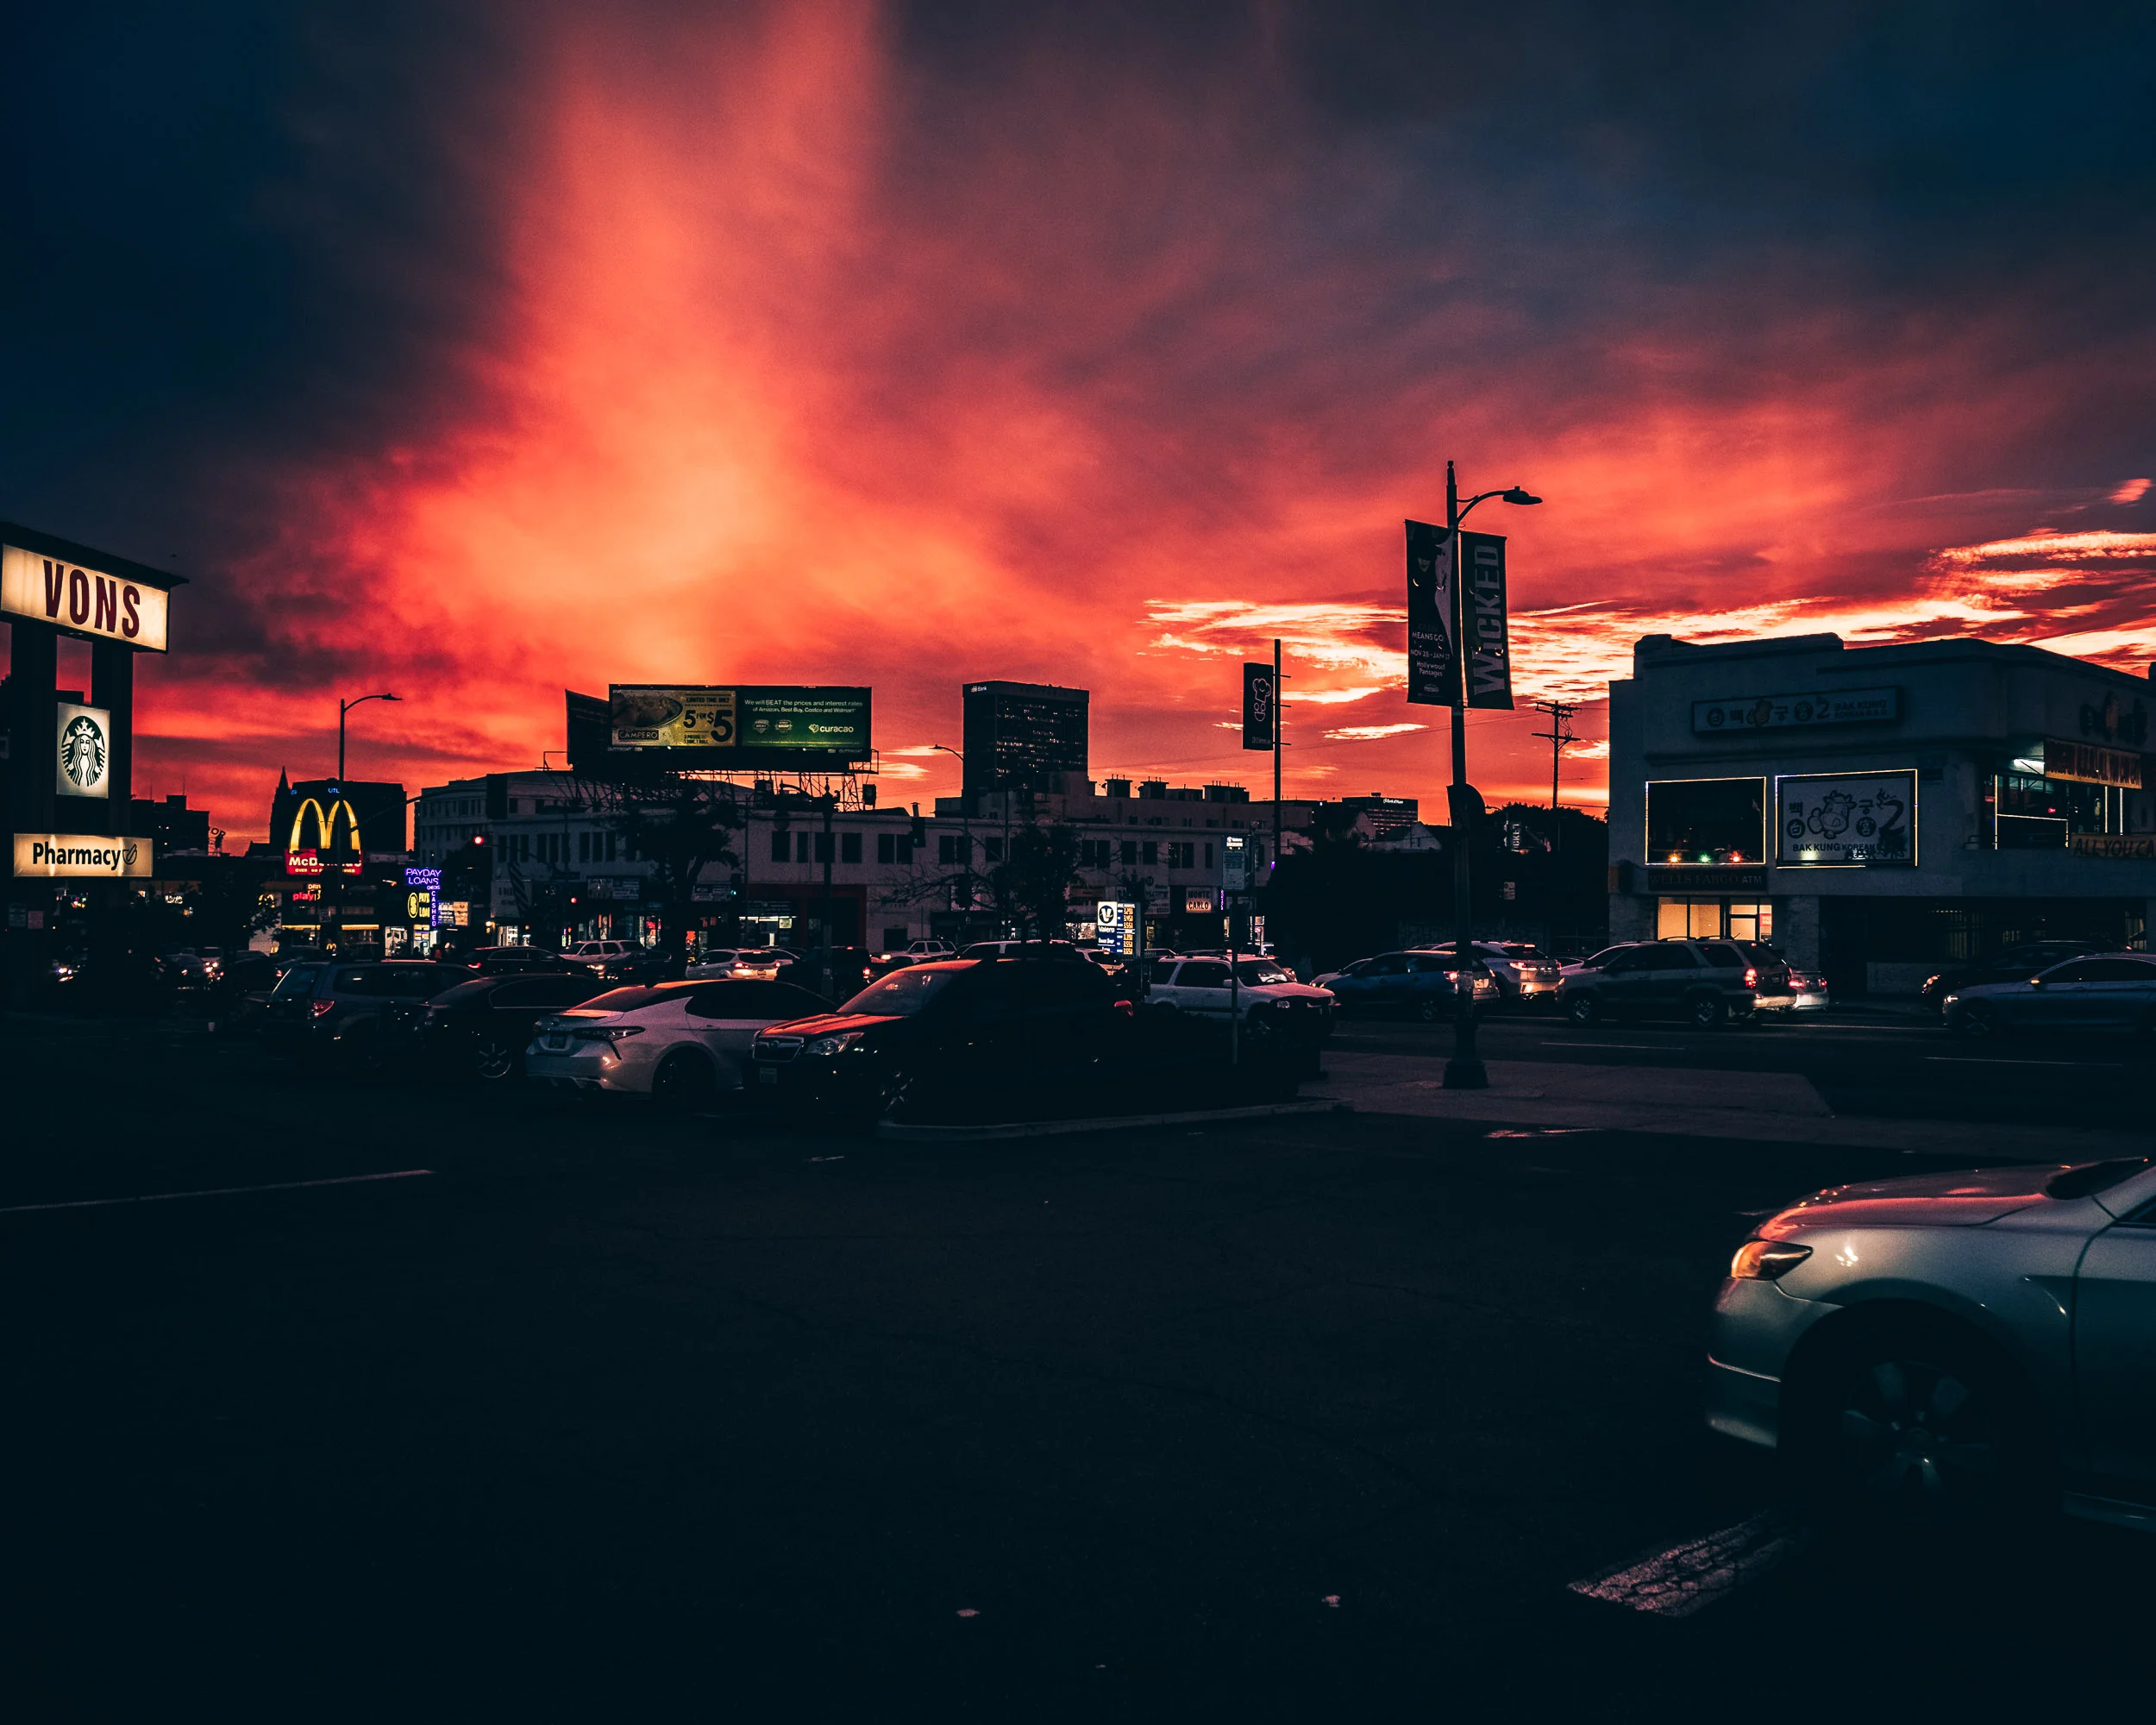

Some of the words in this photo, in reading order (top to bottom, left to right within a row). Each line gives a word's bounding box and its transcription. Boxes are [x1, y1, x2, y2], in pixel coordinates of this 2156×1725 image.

[43, 559, 140, 638] VONS
[1412, 630, 1432, 641] MEANS
[1410, 648, 1421, 656] NOV
[1416, 660, 1445, 670] Hollywood
[683, 710, 696, 728] 5
[619, 731, 658, 739] CAMPERO
[1789, 801, 1802, 817] 백
[1858, 800, 1873, 815] 궁
[1793, 844, 1812, 852] BAK
[1814, 843, 1840, 851] KUNG
[2073, 837, 2099, 856] ALL
[2104, 838, 2134, 856] YOU
[33, 842, 121, 870] Pharmacy
[405, 868, 442, 877] PAYDAY
[408, 876, 440, 885] LOANS
[1649, 874, 1692, 885] WELLS
[1695, 874, 1739, 885] FARGO
[1741, 875, 1762, 885] ATM
[1188, 890, 1210, 899] MONTE
[1188, 901, 1209, 910] CARLO
